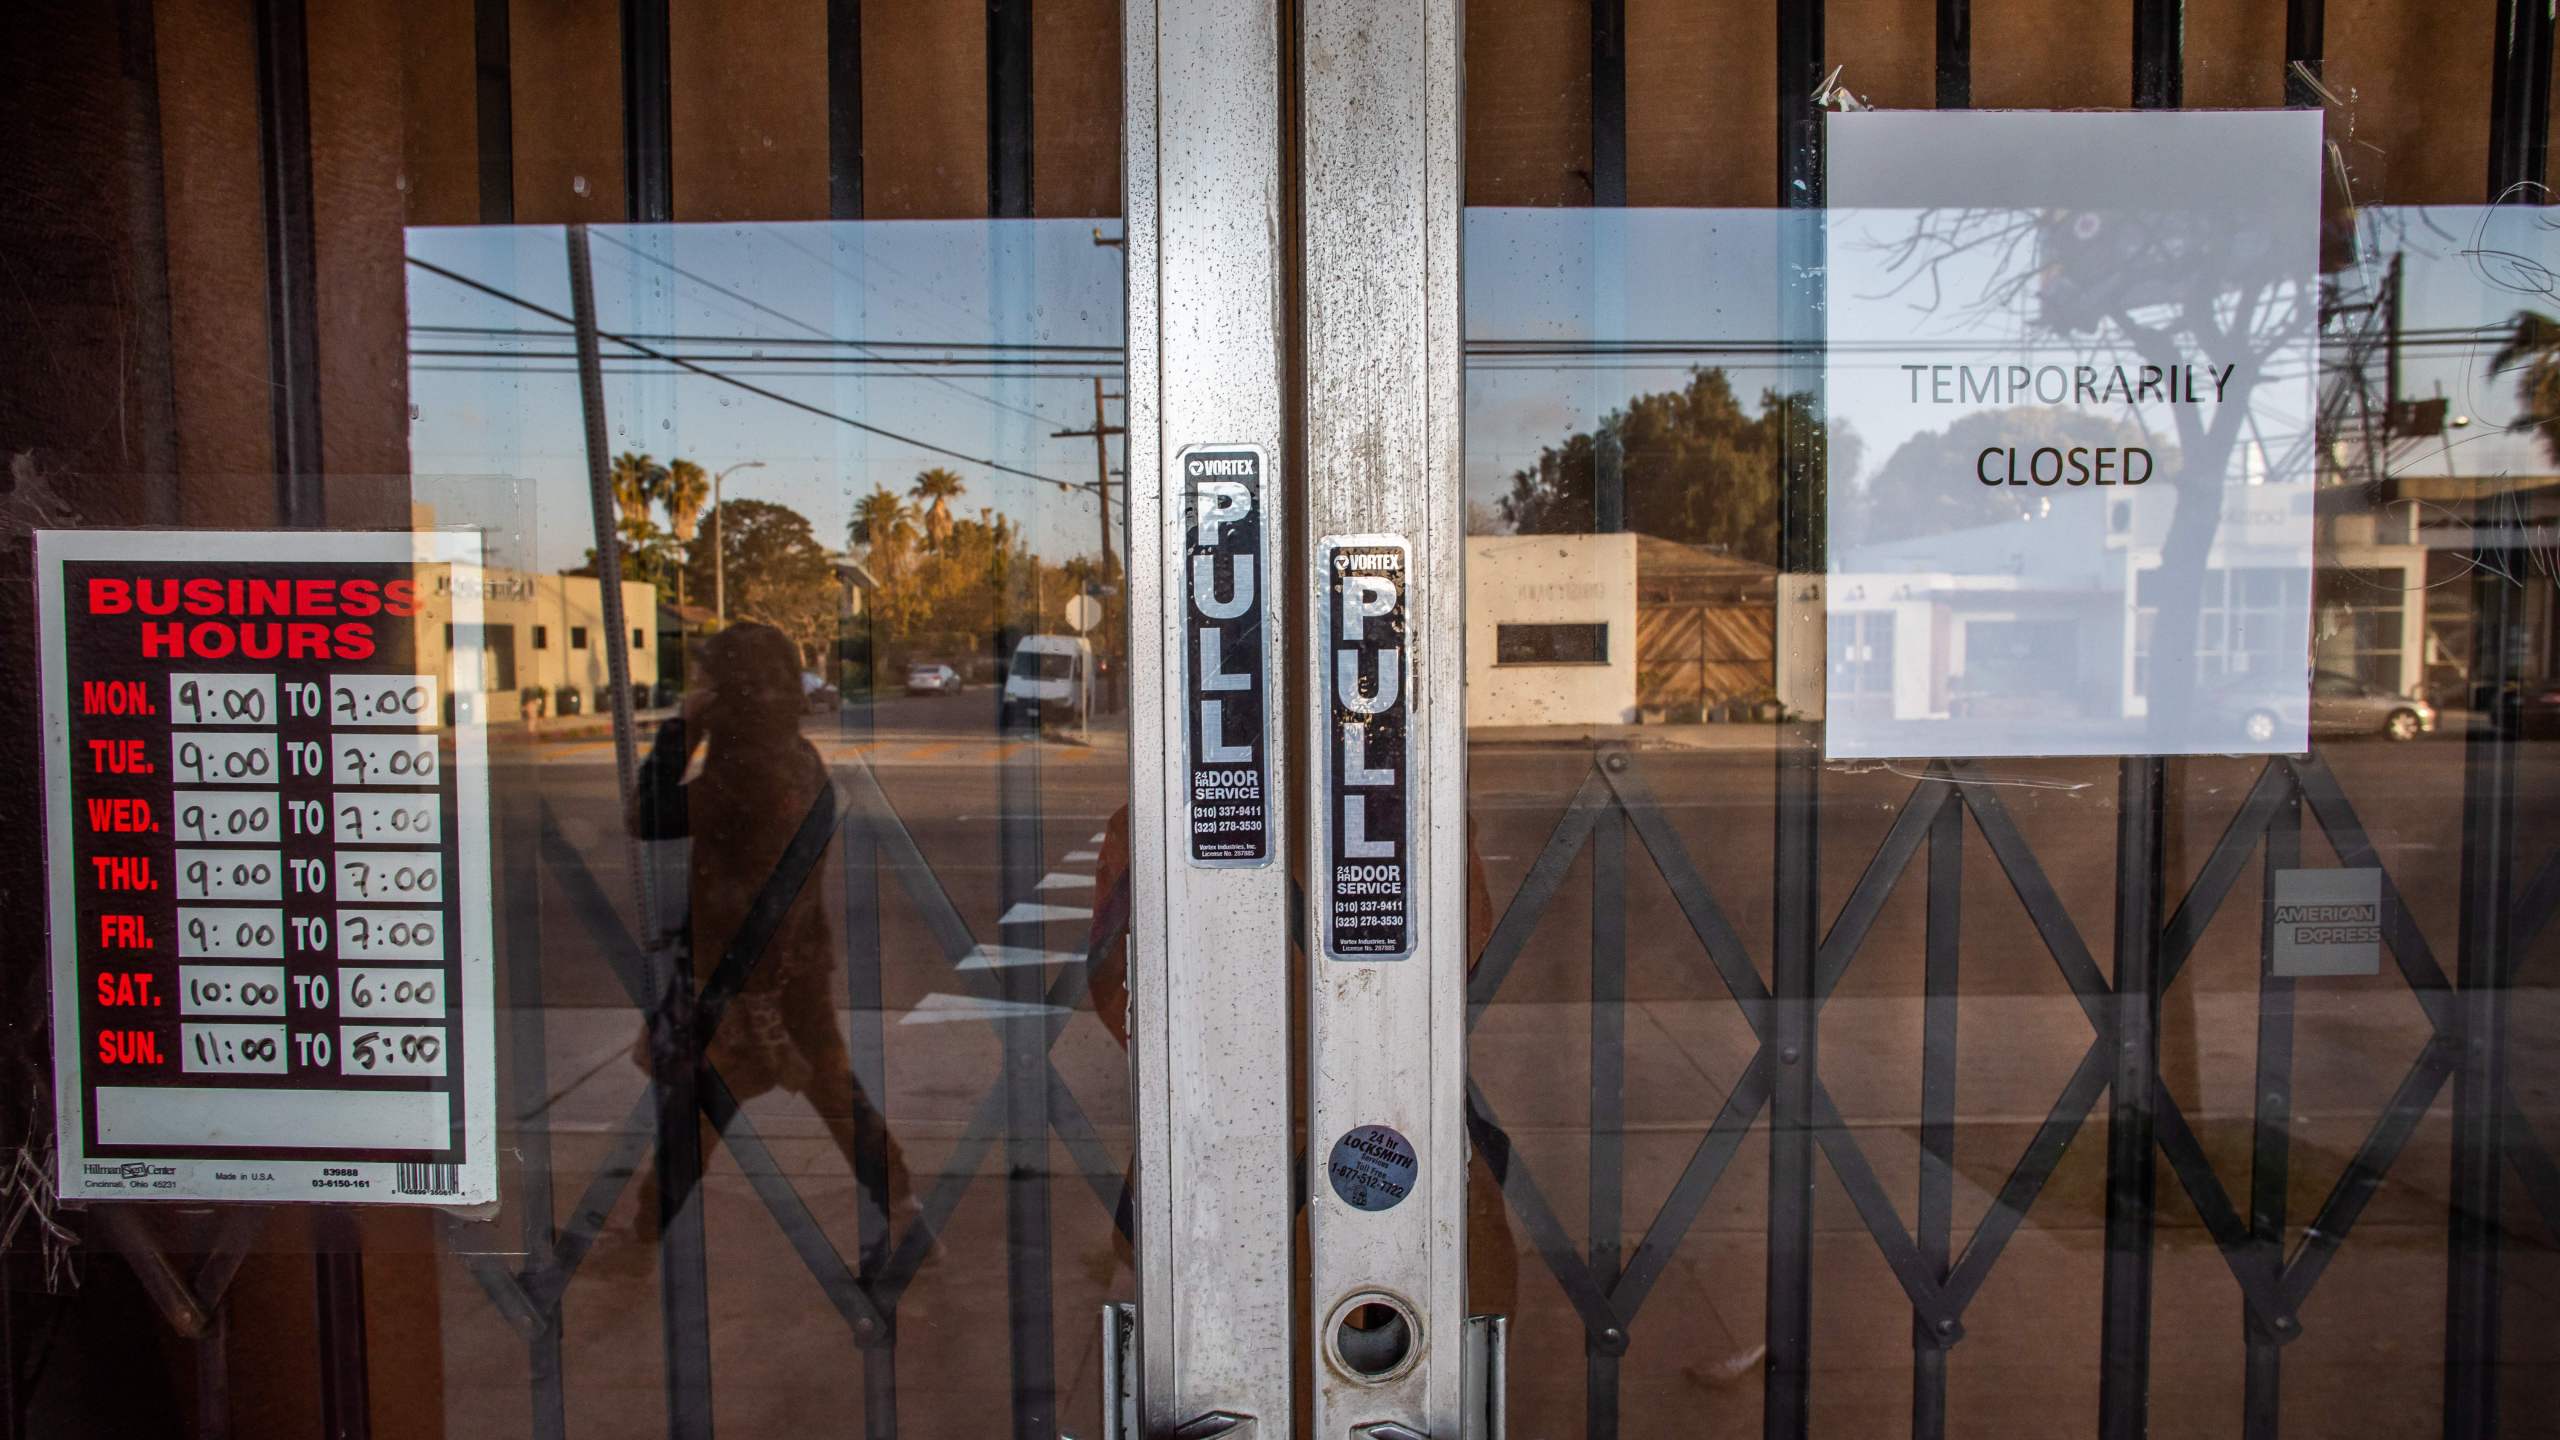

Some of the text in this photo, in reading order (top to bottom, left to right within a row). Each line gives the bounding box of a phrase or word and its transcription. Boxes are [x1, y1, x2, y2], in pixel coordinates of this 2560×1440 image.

[1900, 364, 2235, 404] TEMPORARILY
[1205, 460, 1253, 475] VORTEX
[1977, 447, 2153, 486] CLOSED
[1350, 555, 1399, 570] VORTEX
[88, 578, 423, 617] BUSINESS
[1193, 481, 1255, 763] PULL
[142, 622, 376, 660] HOURS
[83, 681, 429, 722] MON. 9:00 TO 7:00
[1338, 576, 1400, 858] PULL
[89, 739, 433, 784] TUE. 9:00 TO 7:00
[1195, 770, 1258, 787] 24 HR DOOR
[1195, 787, 1260, 800] SERVICE
[88, 798, 431, 840] WED. 9:00 TO 7:00
[1194, 806, 1261, 819] (310) 337-9411
[1194, 820, 1262, 834] (323) 278-3530
[93, 856, 437, 897] THU. 9:00 TO 7:00
[1337, 866, 1349, 874] 24
[1351, 865, 1400, 881] DOOR
[1337, 882, 1401, 894] SERVICE
[1336, 901, 1402, 913] (310) 337-9411
[2274, 904, 2375, 923] AMERICAN
[1336, 916, 1403, 928] (323) 278-3530
[101, 915, 435, 952] FRI. 9:00 TO 7:00
[2295, 926, 2381, 944] EXPRESS
[97, 973, 436, 1009] SAT. 10:00 TO 6:00
[99, 1030, 440, 1070] SUN. 11:00 TO 5:00
[1368, 1131, 1399, 1149] 24 hr
[1344, 1135, 1414, 1168] LOCKSMITH
[216, 1172, 275, 1181] Made in U.S.A.
[1356, 1161, 1388, 1179] Toll Free
[130, 1180, 148, 1188] Ohio
[152, 1181, 177, 1189] 45231
[312, 1180, 370, 1188] 03-6150-161
